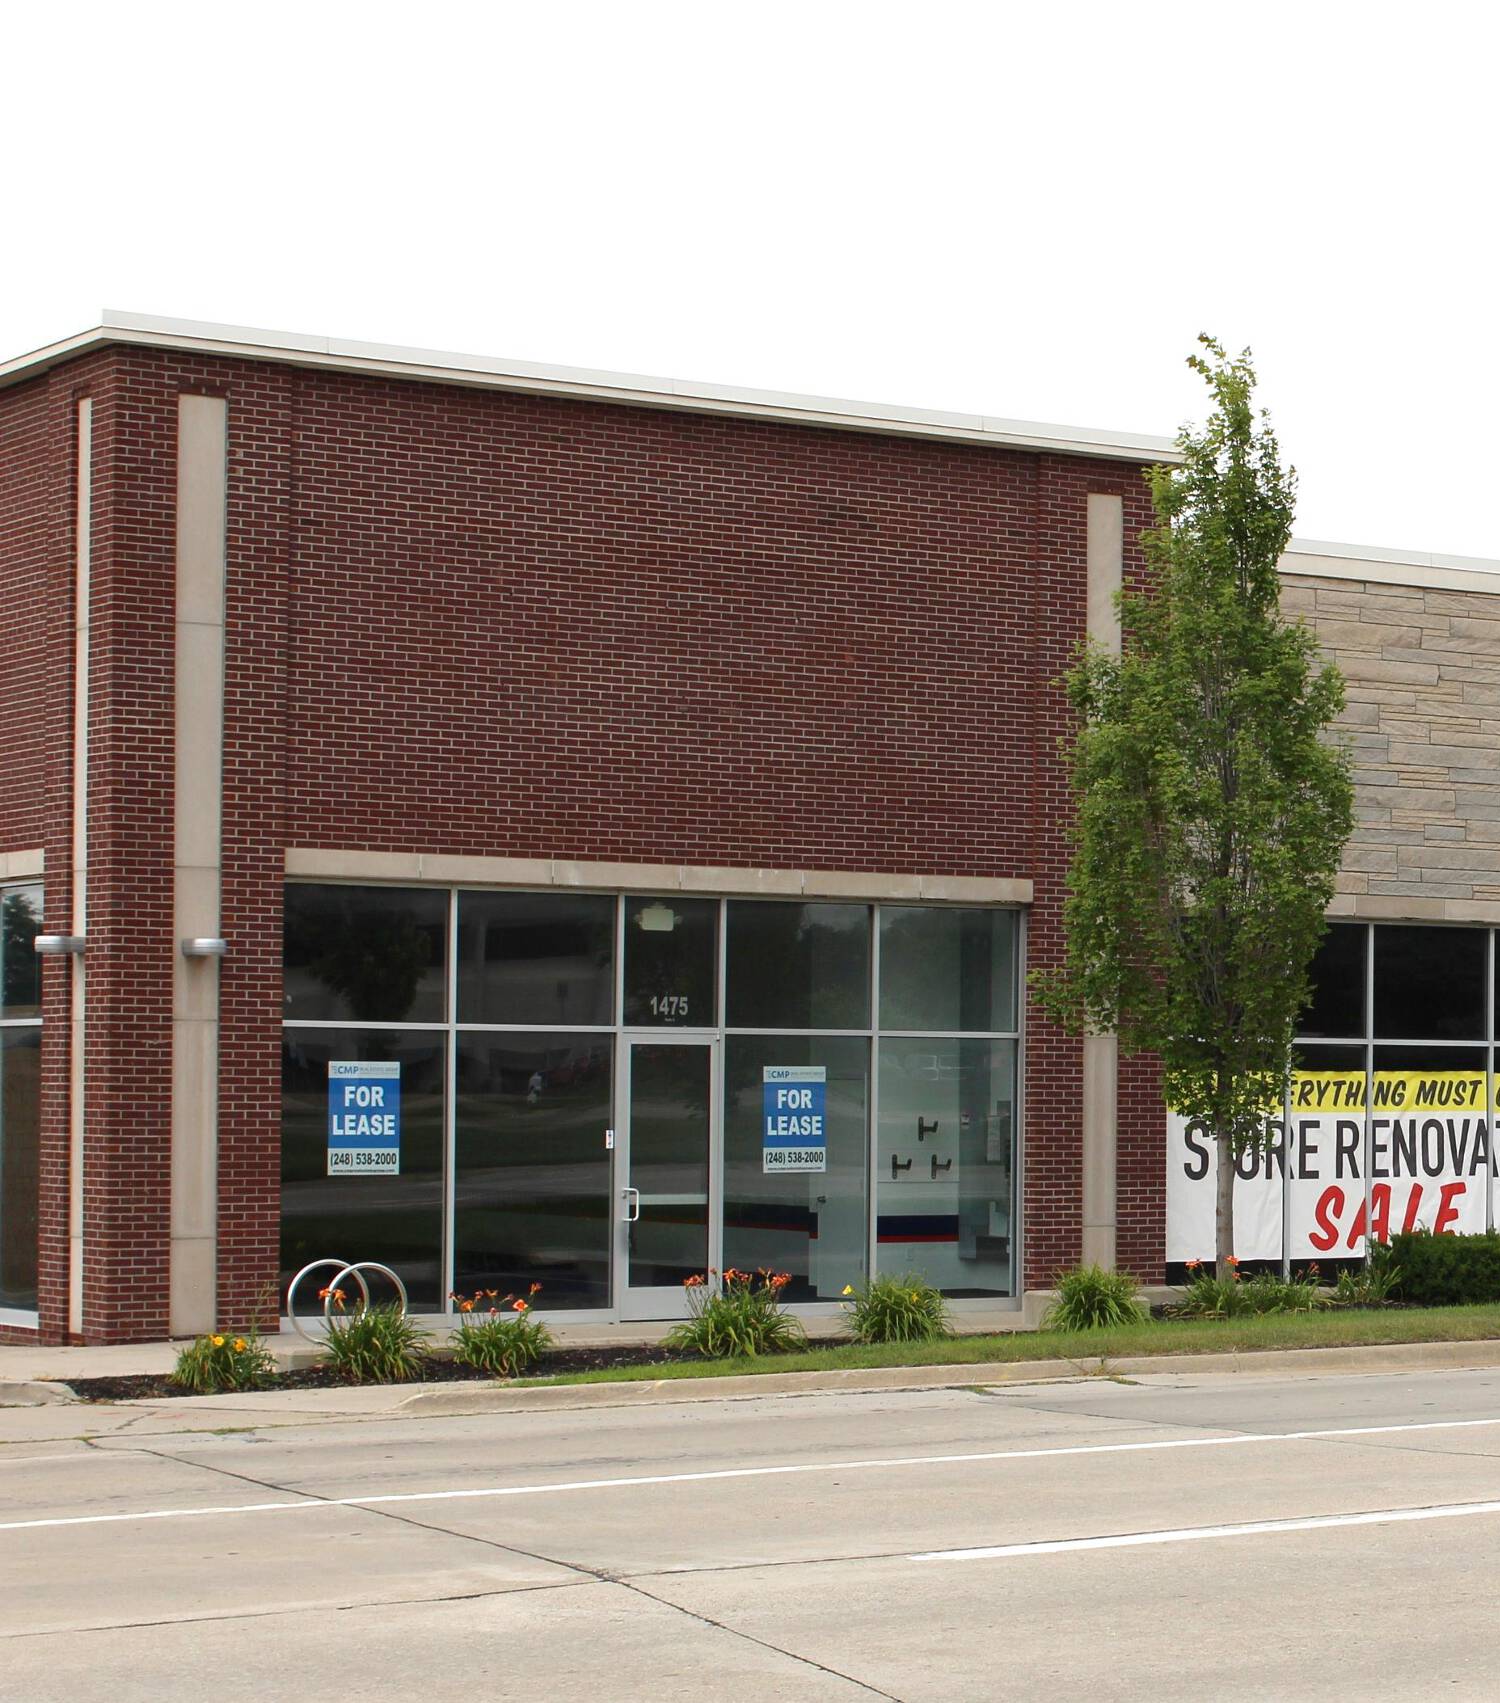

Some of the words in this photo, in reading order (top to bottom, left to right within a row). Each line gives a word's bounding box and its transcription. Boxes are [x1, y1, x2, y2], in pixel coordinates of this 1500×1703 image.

[650, 996, 689, 1016] 1475
[338, 1065, 359, 1075] CMP
[344, 1086, 384, 1107] FOR
[777, 1089, 812, 1109] FOR
[1415, 1079, 1482, 1106] MUST
[332, 1114, 396, 1136] LEASE
[767, 1115, 822, 1136] LEASE
[330, 1153, 353, 1167] (248)
[356, 1153, 397, 1165] 538-2000
[765, 1151, 786, 1164] (248)
[788, 1151, 824, 1163] 538-2000
[1184, 1119, 1320, 1181] SORE
[1309, 1182, 1467, 1251] SALE
